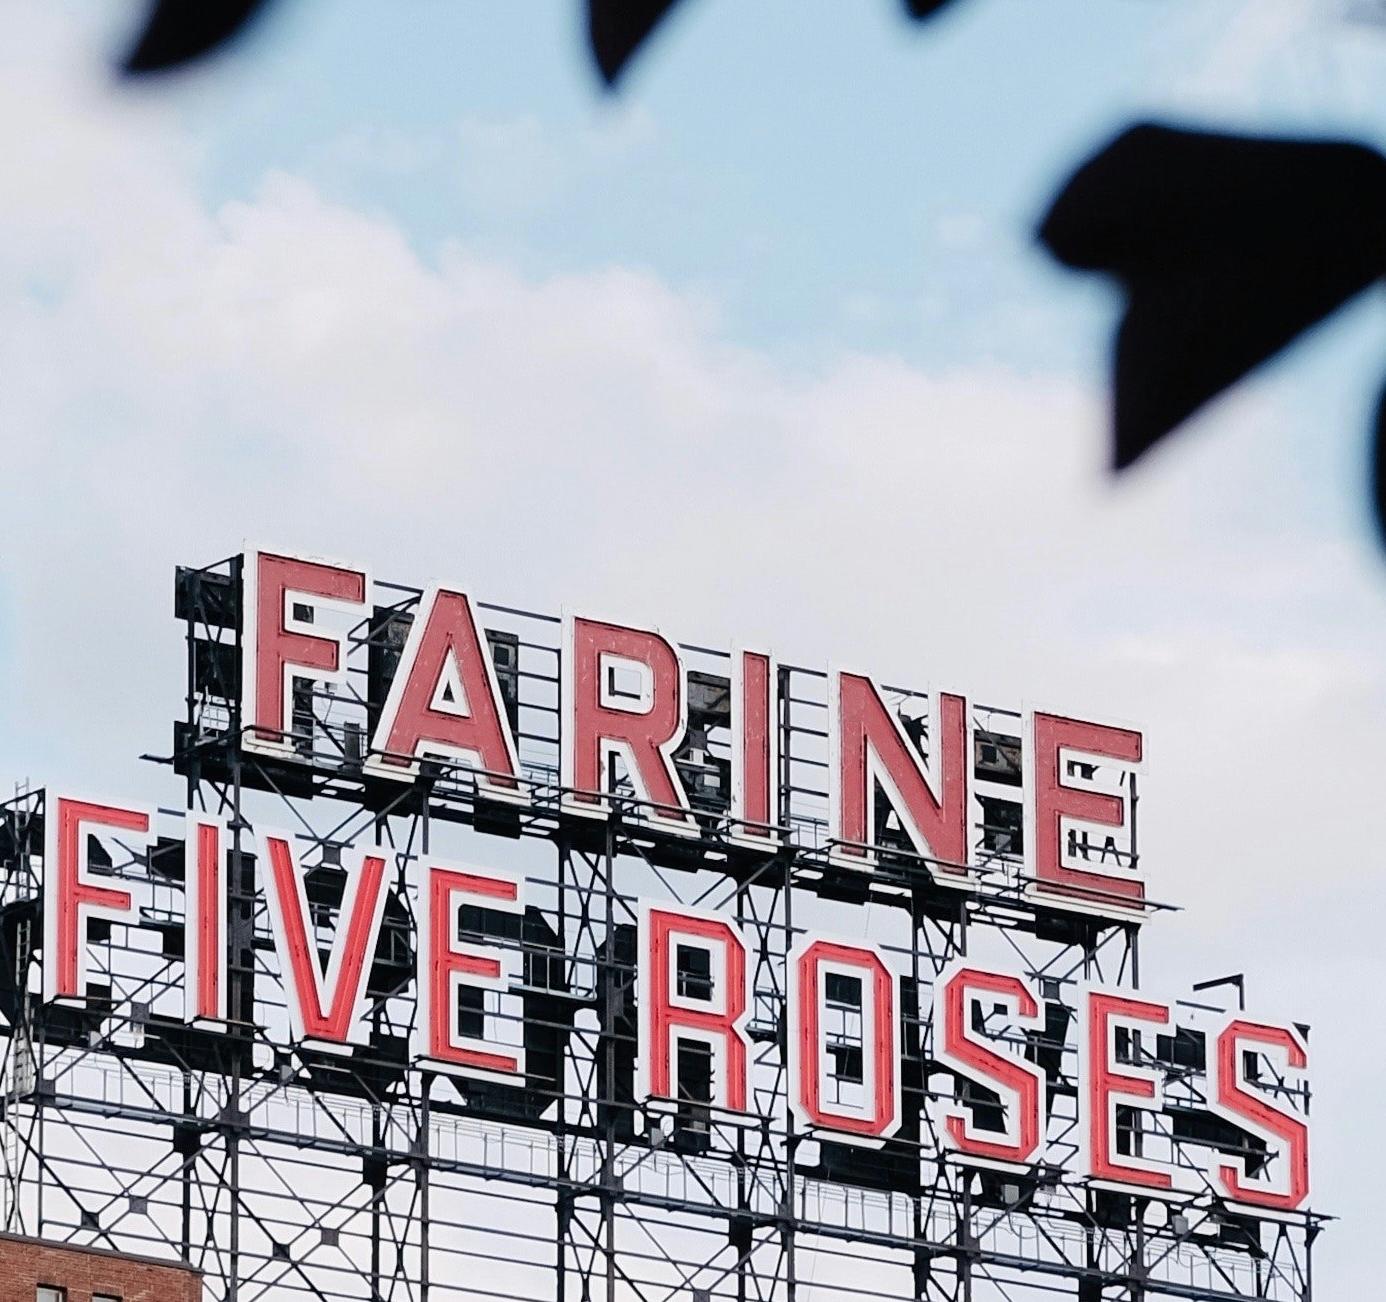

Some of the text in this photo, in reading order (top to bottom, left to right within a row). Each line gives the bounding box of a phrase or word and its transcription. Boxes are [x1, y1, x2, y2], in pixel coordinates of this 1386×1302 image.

[241, 547, 1153, 916] FARINE
[44, 792, 1311, 1212] FIVE ROSES
